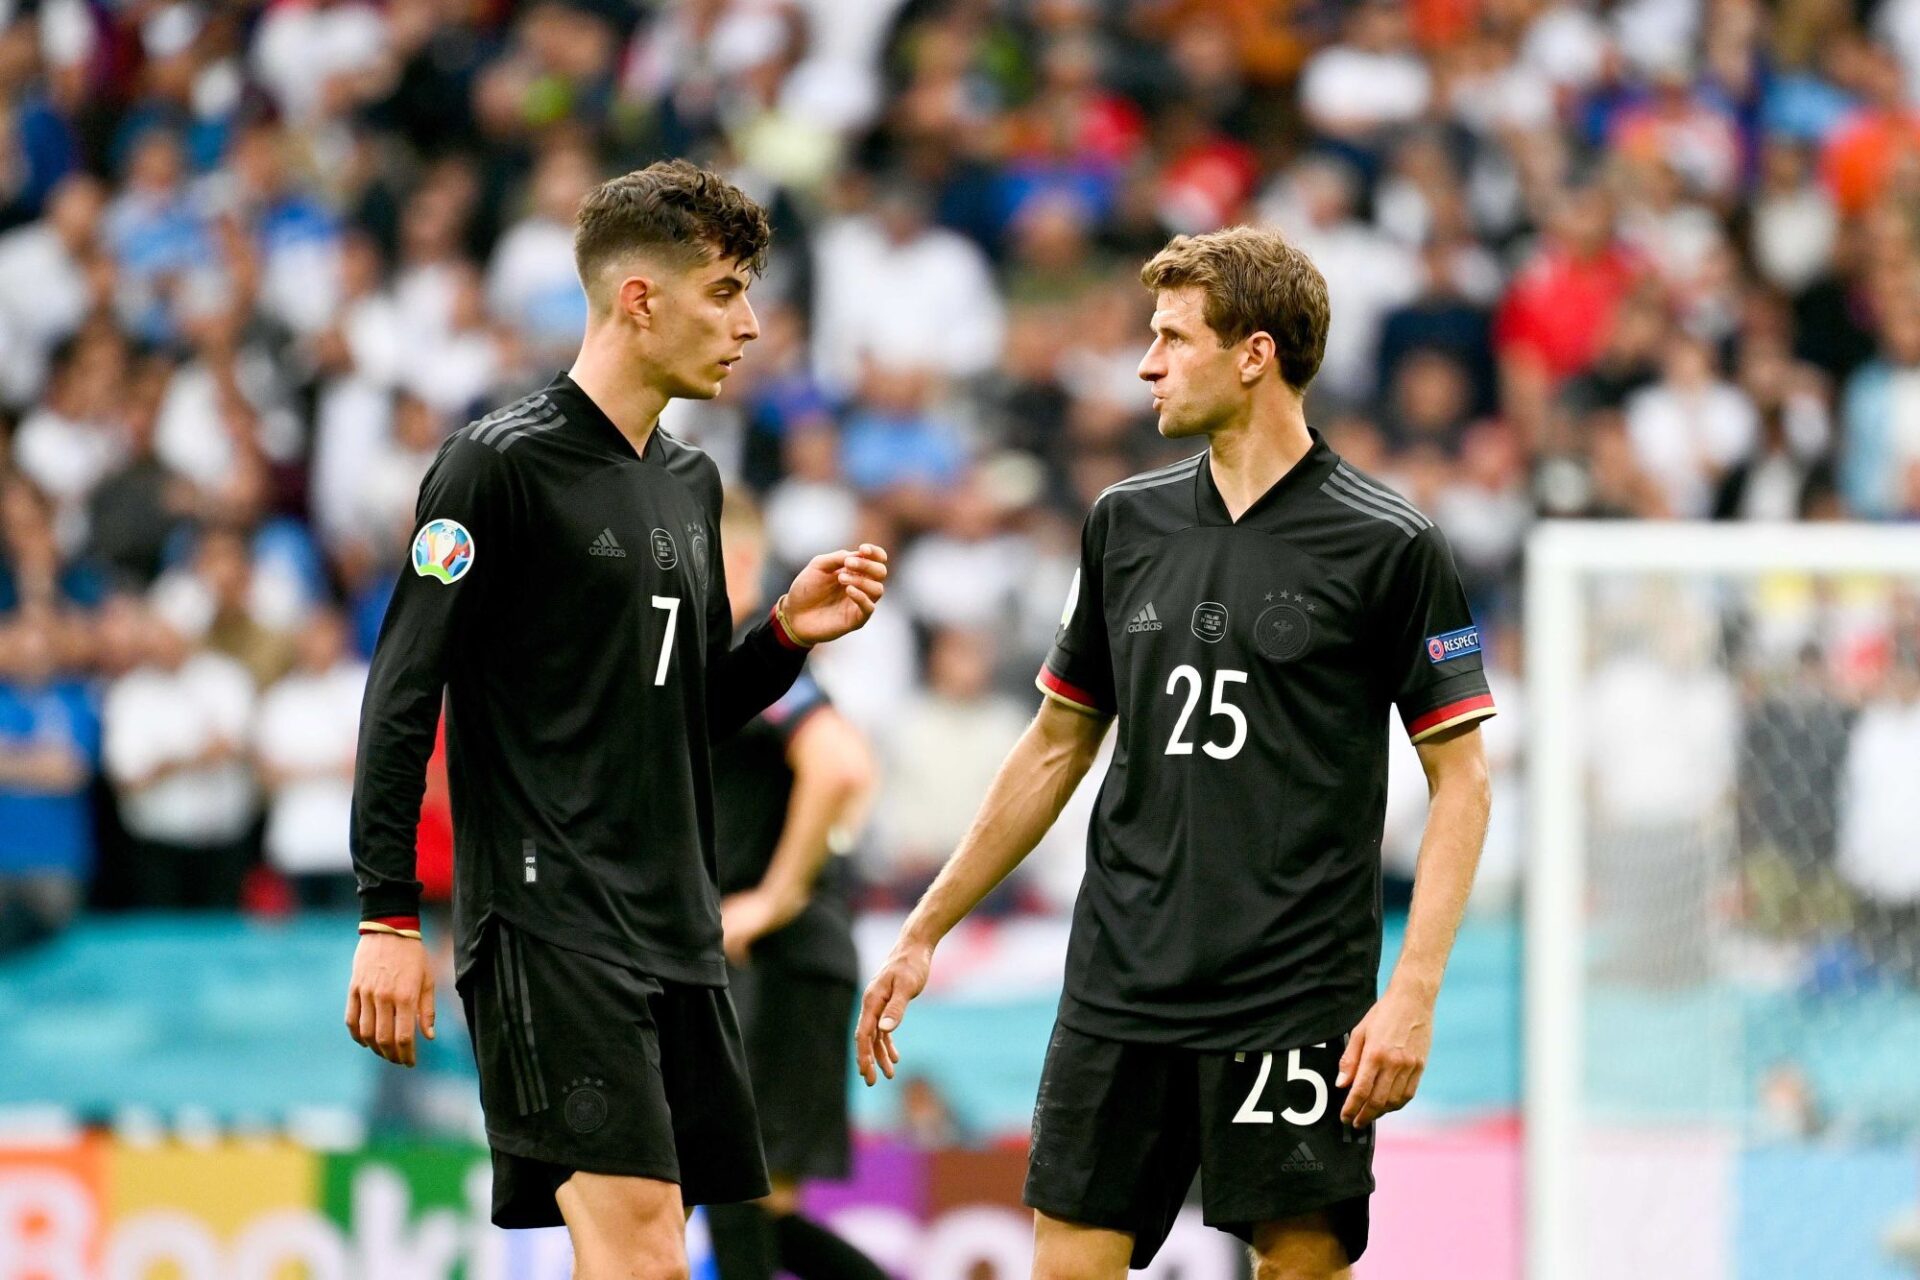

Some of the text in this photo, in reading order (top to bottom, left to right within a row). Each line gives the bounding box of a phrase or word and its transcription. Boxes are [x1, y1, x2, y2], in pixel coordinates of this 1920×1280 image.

[588, 545, 626, 558] adidas
[651, 595, 680, 686] 7
[1128, 620, 1162, 633] adidas
[1443, 632, 1479, 652] RESPECT
[1164, 664, 1248, 760] 25
[1232, 1042, 1328, 1126] 25
